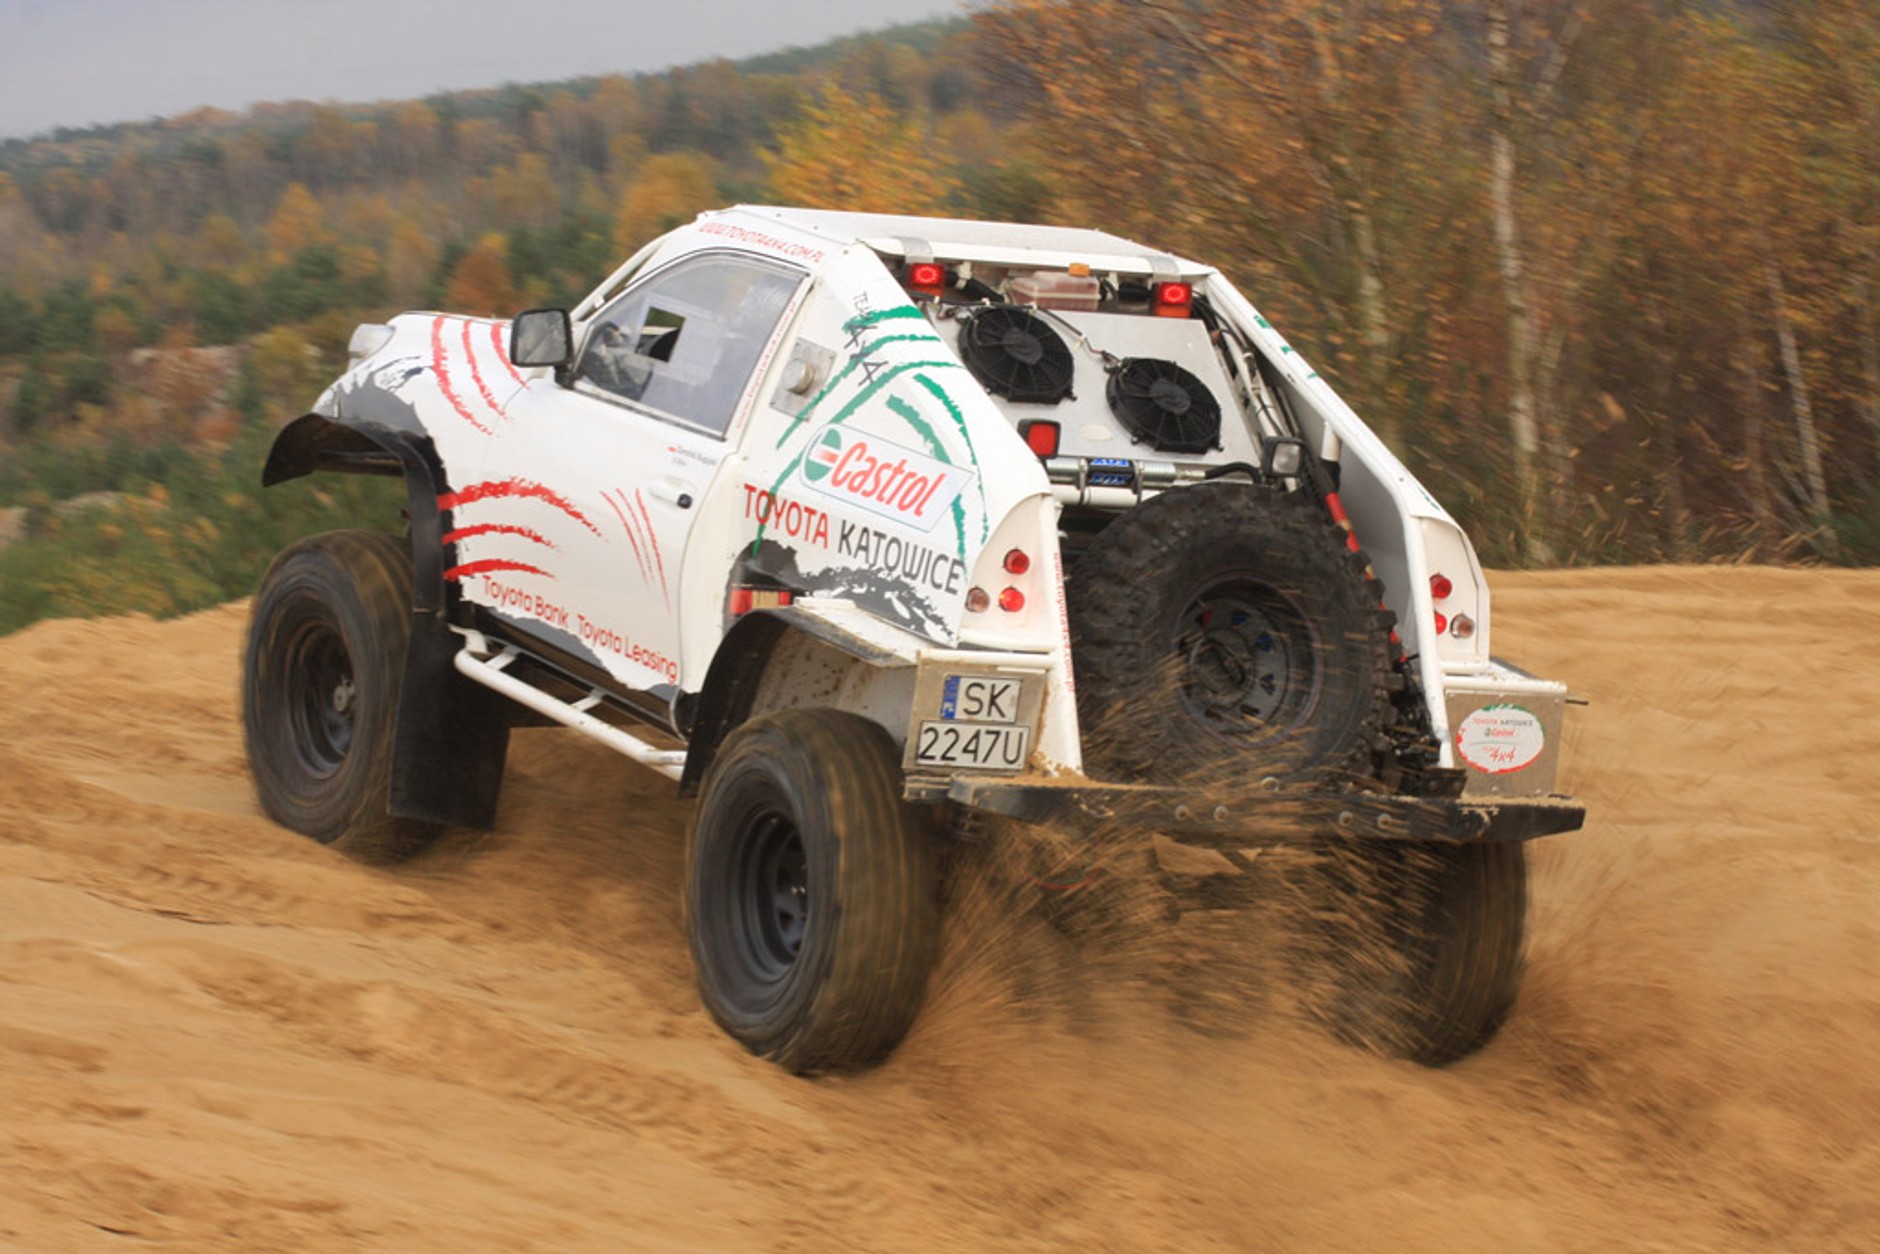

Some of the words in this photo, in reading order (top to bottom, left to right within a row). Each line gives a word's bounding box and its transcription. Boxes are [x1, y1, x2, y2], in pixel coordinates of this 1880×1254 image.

[830, 441, 946, 517] Castrol
[744, 483, 829, 549] TOYOTA
[838, 519, 965, 596] KATOWICE
[482, 575, 532, 613] Toyota
[534, 594, 569, 629] Bank
[577, 613, 622, 654] Toyota
[624, 637, 679, 686] Leasing
[963, 682, 1011, 718] SK
[920, 726, 1024, 765] 2247U
